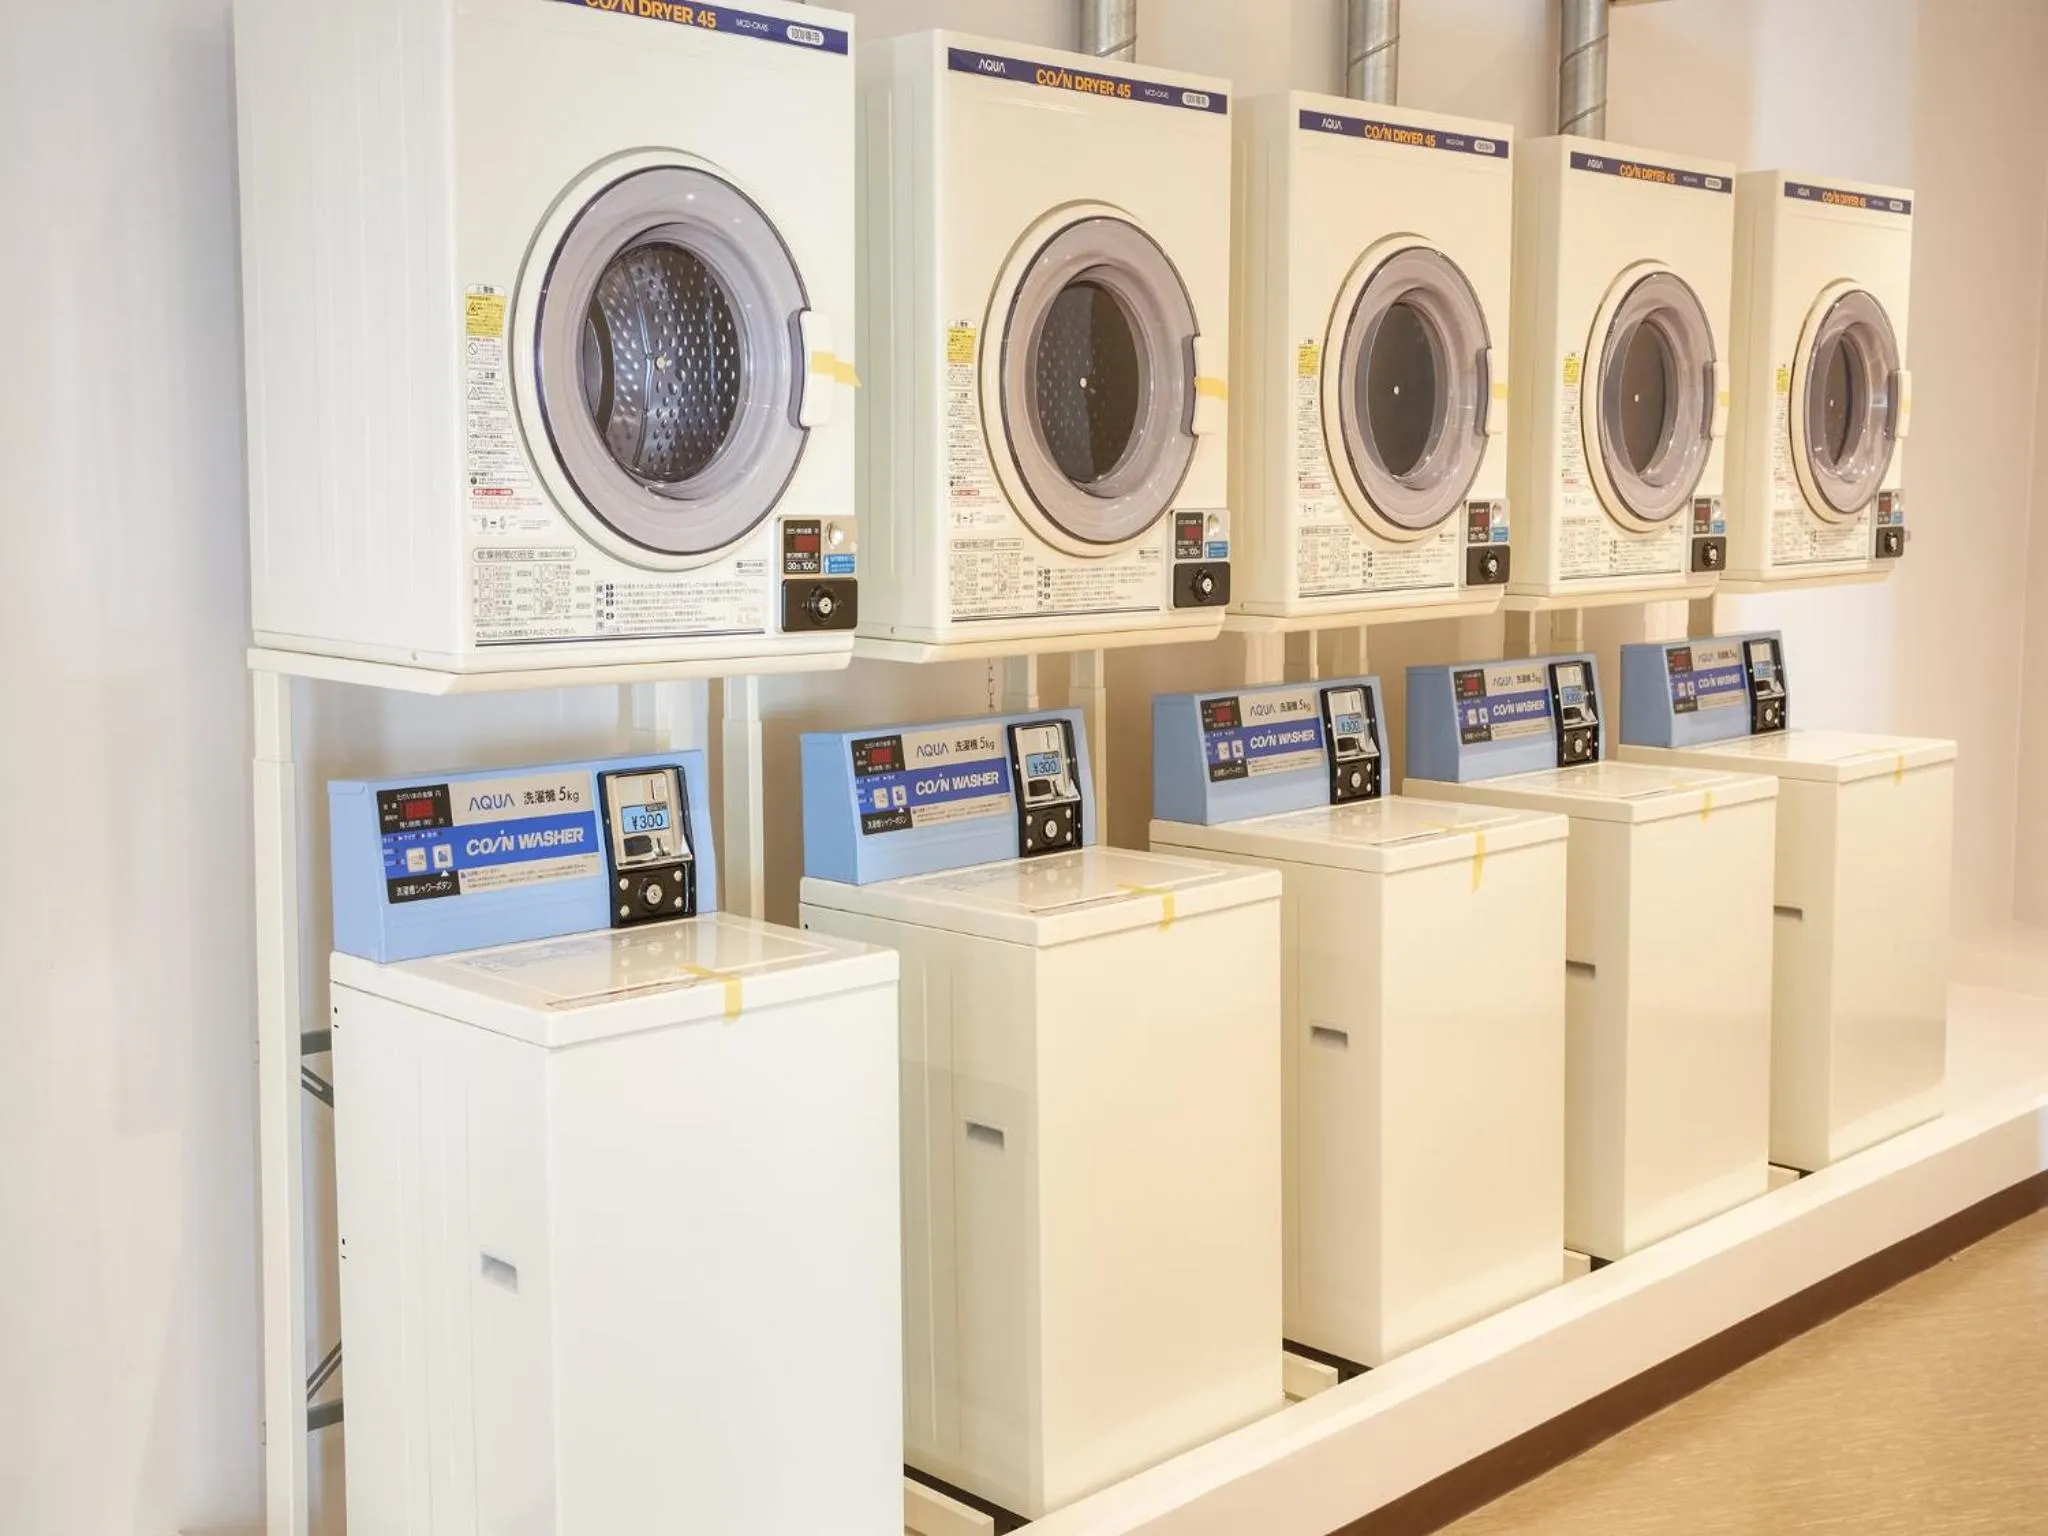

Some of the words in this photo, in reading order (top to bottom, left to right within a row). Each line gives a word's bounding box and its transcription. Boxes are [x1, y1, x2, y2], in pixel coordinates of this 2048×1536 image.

[639, 0, 693, 24] DRYER
[697, 10, 716, 28] 45
[978, 59, 1005, 73] AQUA
[1075, 75, 1115, 96] DRYER
[1117, 82, 1132, 98] 45
[1393, 130, 1424, 145] DRYER
[1425, 135, 1436, 147] 45
[915, 742, 949, 758] AQUA
[979, 735, 995, 750] 5kg
[1278, 729, 1315, 745] WASHER
[1032, 760, 1058, 775] ¥300
[952, 771, 1000, 790] WASHER
[469, 793, 515, 812] AQUA
[523, 789, 555, 805] 洗濯機
[558, 786, 580, 803] 5kg
[631, 813, 663, 831] ¥300
[518, 827, 584, 850] WASHER
